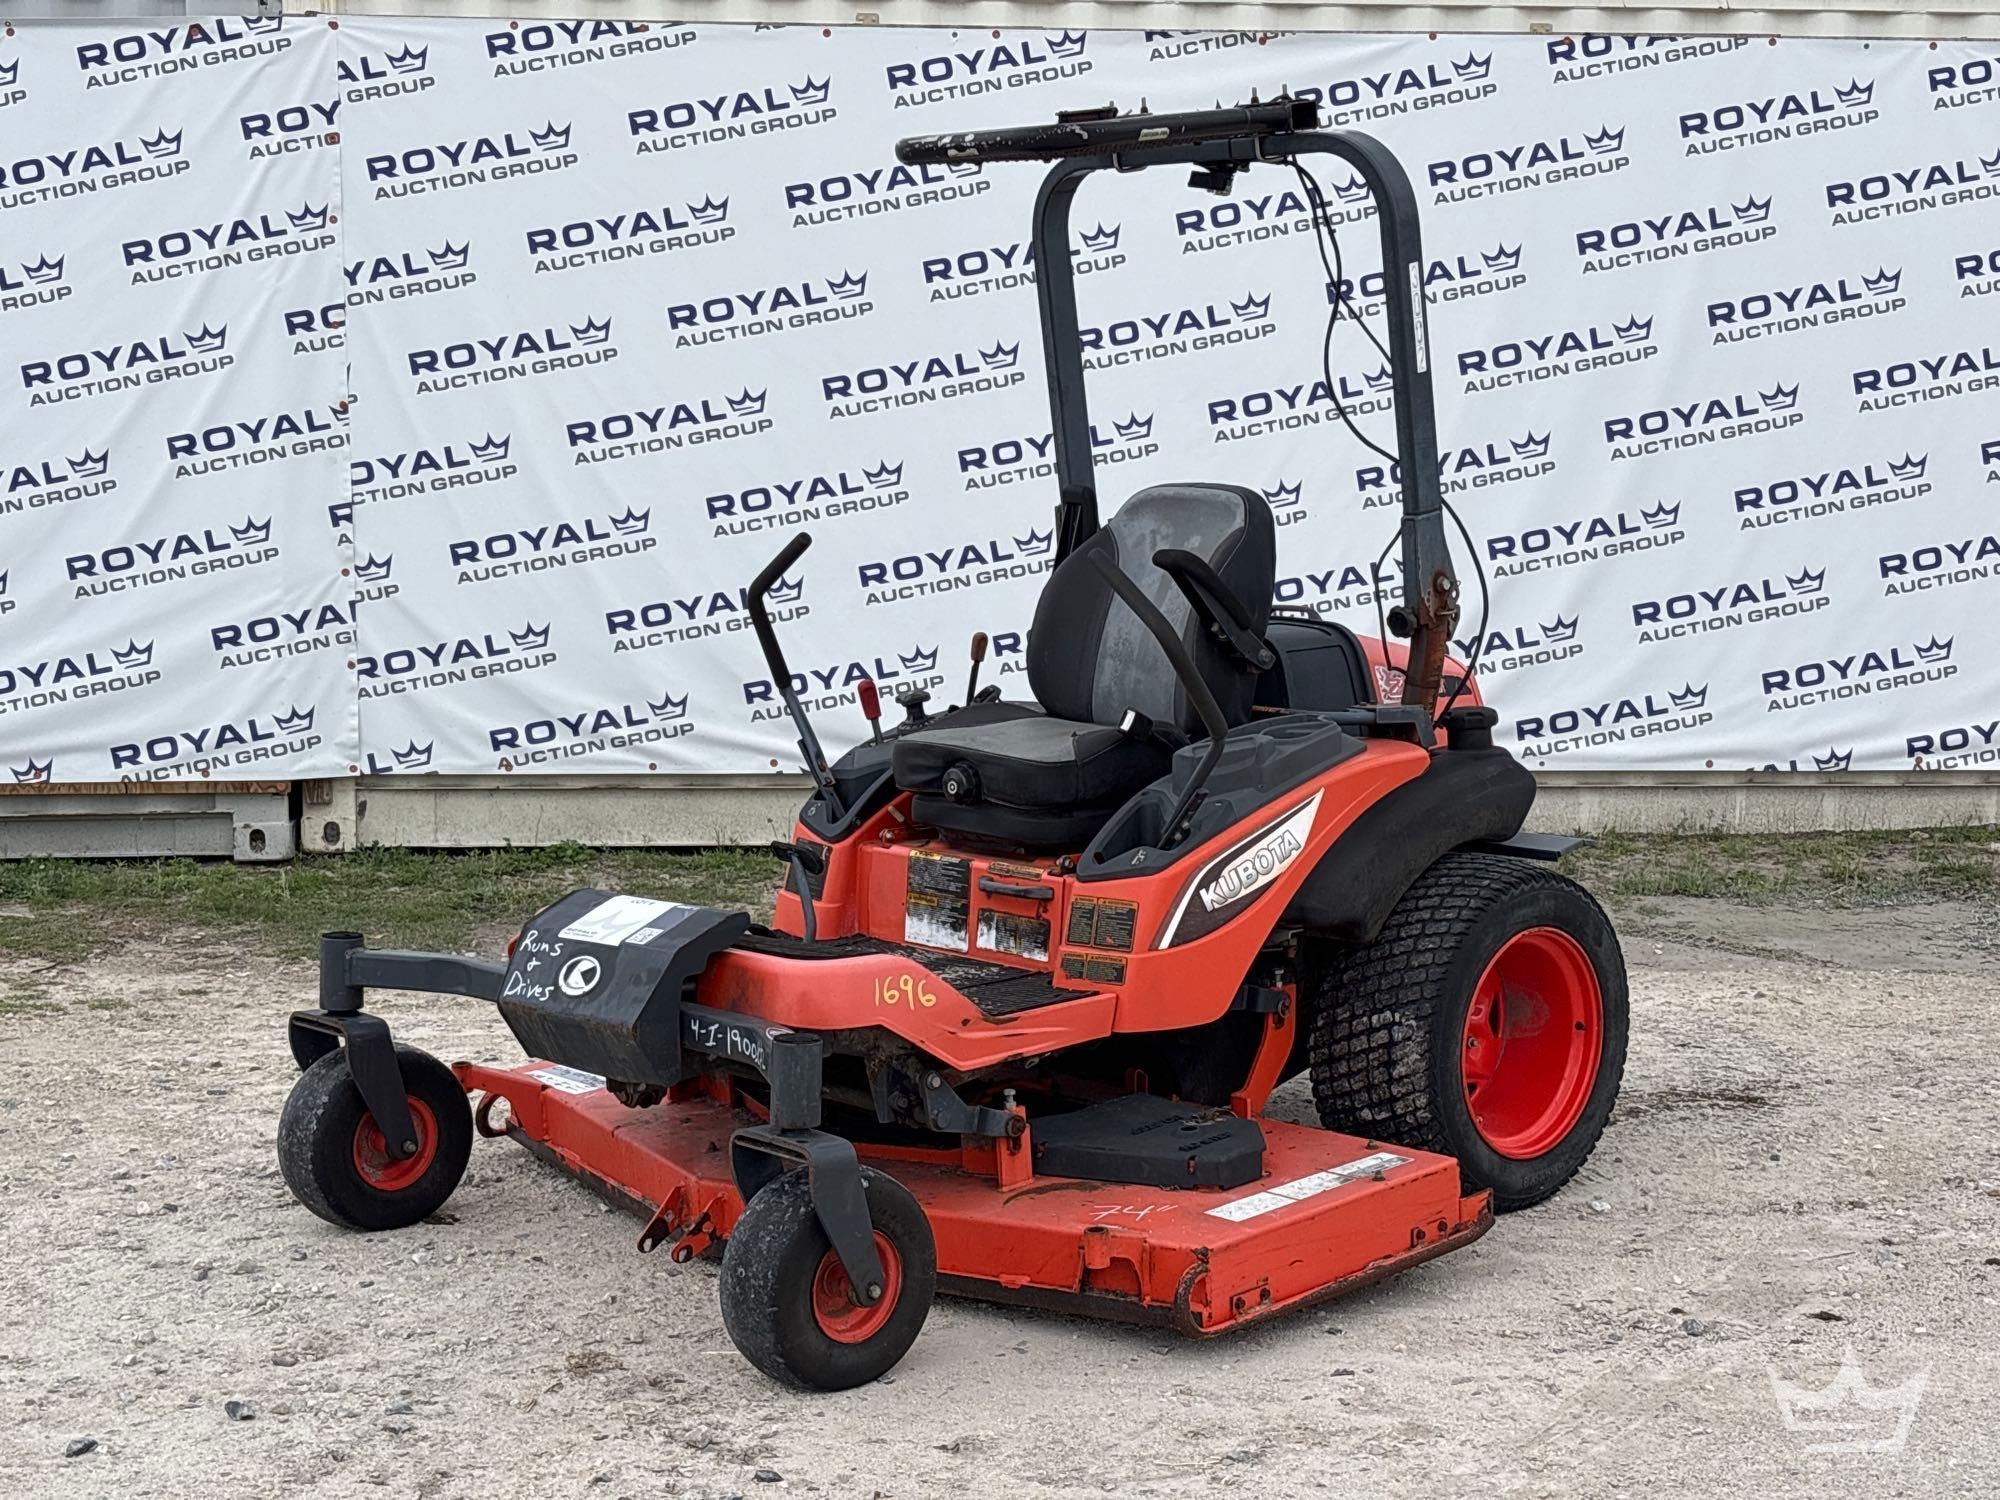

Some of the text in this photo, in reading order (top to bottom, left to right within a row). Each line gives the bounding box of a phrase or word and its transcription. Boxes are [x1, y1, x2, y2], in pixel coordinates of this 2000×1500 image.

[77, 19, 243, 70] ROYAL
[86, 37, 292, 90] AUCTION GROUP
[494, 31, 697, 78] AUCTION GROUP
[886, 41, 1047, 90] ROYAL
[1149, 31, 1257, 62] AUCTION
[1554, 37, 1750, 83] AUCTION GROUP
[347, 77, 434, 102] GROUP
[894, 60, 1093, 109] AUCTION GROUP
[1318, 84, 1496, 129] UCTION GROUP
[240, 95, 341, 140] ROY
[627, 88, 791, 136] ROYAL
[636, 108, 837, 155] AUCTION GROUP
[1679, 90, 1835, 139] ROYAL
[1685, 109, 1879, 157] AUCTION GROUP
[365, 133, 531, 182] ROYAL
[374, 153, 578, 201] AUCTION GROUP
[1427, 137, 1585, 187] ROYAL
[1434, 156, 1630, 206] AUCTION GROUP
[0, 161, 190, 209] UCTION GROUP
[785, 164, 945, 210] ROYAL
[792, 180, 991, 228] AUCTION GROUP
[1825, 160, 1981, 208] ROYAL
[1832, 185, 2000, 226] AUCTION GROU
[121, 214, 288, 267] ROYAL
[526, 207, 690, 255] ROYAL
[534, 227, 736, 274] AUCTION GROUP
[1183, 223, 1288, 254] AUCTION
[1576, 207, 1733, 256] ROYAL
[1582, 225, 1777, 274] AUCTION GROUP
[131, 234, 336, 286] AUCTION GROUP
[344, 253, 429, 286] YAL
[2, 286, 72, 311] ROUP
[389, 273, 476, 298] GROUP
[667, 282, 828, 331] ROYAL
[931, 271, 1038, 302] AUCTION
[1443, 275, 1526, 301] GROUP
[1707, 279, 1863, 328] ROYAL
[675, 301, 874, 349] AUCTION GROUP
[1079, 306, 1231, 353] ROYAL
[1713, 297, 1906, 346] AUCTION GROUP
[20, 336, 187, 389] ROYAL
[407, 328, 572, 376] ROYAL
[416, 347, 618, 395] AUCTION GROUP
[1081, 324, 1275, 371] AUCTION GROUP
[1457, 327, 1614, 376] ROYAL
[1464, 345, 1658, 394] AUCTION GROUP
[1852, 347, 2000, 395] ROYAL
[30, 355, 234, 408] AUCTION GROUP
[821, 353, 981, 401] ROYAL
[829, 371, 1025, 420] AUCTION GROUP
[1208, 376, 1363, 424] ROYAL
[1859, 383, 1962, 412] AUCTION
[166, 409, 332, 460] ROYAL
[566, 399, 728, 447] ROYAL
[574, 418, 774, 466] AUCTION GROUP
[1215, 397, 1392, 442] AUCTION GROU
[1604, 394, 1760, 443] ROYAL
[1610, 412, 1804, 461] AUCTION GROUP
[176, 446, 286, 478] AUCTION
[351, 446, 470, 486] OYAL
[958, 425, 1113, 473] ROYL
[1093, 444, 1159, 467] ROUP
[29, 480, 116, 507] GROUP
[352, 465, 517, 506] CTION GROUP
[705, 472, 865, 520] ROYAL
[1473, 462, 1555, 487] GROUP
[1734, 465, 1889, 513] ROYAL
[713, 490, 910, 538] AUCTION GROUP
[1740, 482, 1932, 531] AUCTION GROUP
[65, 529, 232, 581] ROYAL
[448, 518, 611, 567] ROYAL
[1486, 512, 1642, 561] ROYAL
[1493, 530, 1685, 579] AUCTION GROUP
[1879, 536, 2000, 578] ROYA
[74, 547, 279, 600] AUCTION GROUP
[457, 537, 657, 585] AUCTION GROUP
[858, 540, 1015, 588] ROYAL
[1275, 562, 1395, 602] OYAL
[1885, 566, 1988, 596] AUCTION
[606, 588, 748, 634] ROYA
[866, 575, 970, 605] AUCTION
[1631, 579, 1787, 627] ROYAL
[211, 603, 356, 651] ROYA
[614, 623, 720, 652] AUCTION
[1638, 596, 1830, 644] AUCTION GROUP
[221, 636, 330, 669] AUCTION
[356, 634, 511, 682] ROYAL
[357, 652, 557, 701] AUCTION GROUP
[1502, 645, 1583, 670] GROUP
[1761, 647, 1915, 695] ROYAL
[73, 671, 160, 698] GROUP
[1767, 664, 1958, 713] AUCTION GROUP
[489, 704, 650, 753] ROYAL
[1515, 695, 1669, 742] ROYAL
[1521, 712, 1713, 759] AUCTION GROUP
[109, 718, 276, 770] ROYAL
[235, 736, 321, 763] GROUP
[497, 722, 695, 772] AUCTION GROUP
[1199, 829, 1302, 912] KUBOTA
[520, 930, 564, 957] Runs
[503, 971, 555, 1001] Drives
[874, 974, 938, 1012] 1696
